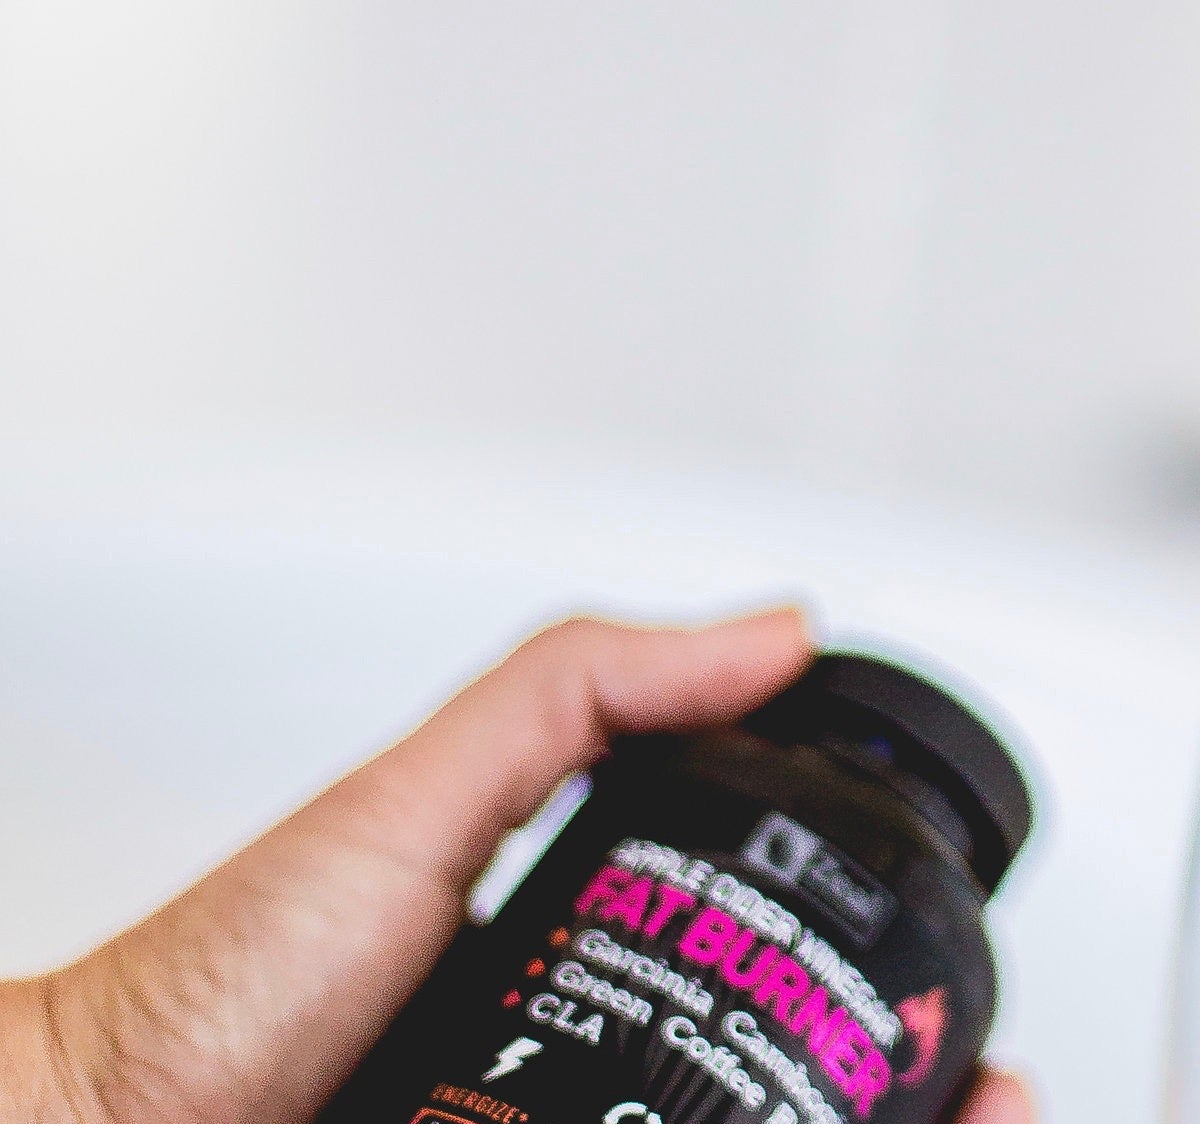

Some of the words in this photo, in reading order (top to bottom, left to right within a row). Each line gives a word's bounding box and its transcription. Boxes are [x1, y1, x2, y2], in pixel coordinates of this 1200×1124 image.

[706, 872, 801, 948] CIDER
[526, 993, 604, 1044] CLA
[573, 929, 714, 1019] Garcinia
[574, 865, 697, 938] FAT
[678, 904, 891, 1120] BURNER
[551, 960, 653, 1026] Green
[661, 1014, 767, 1111] Coffee
